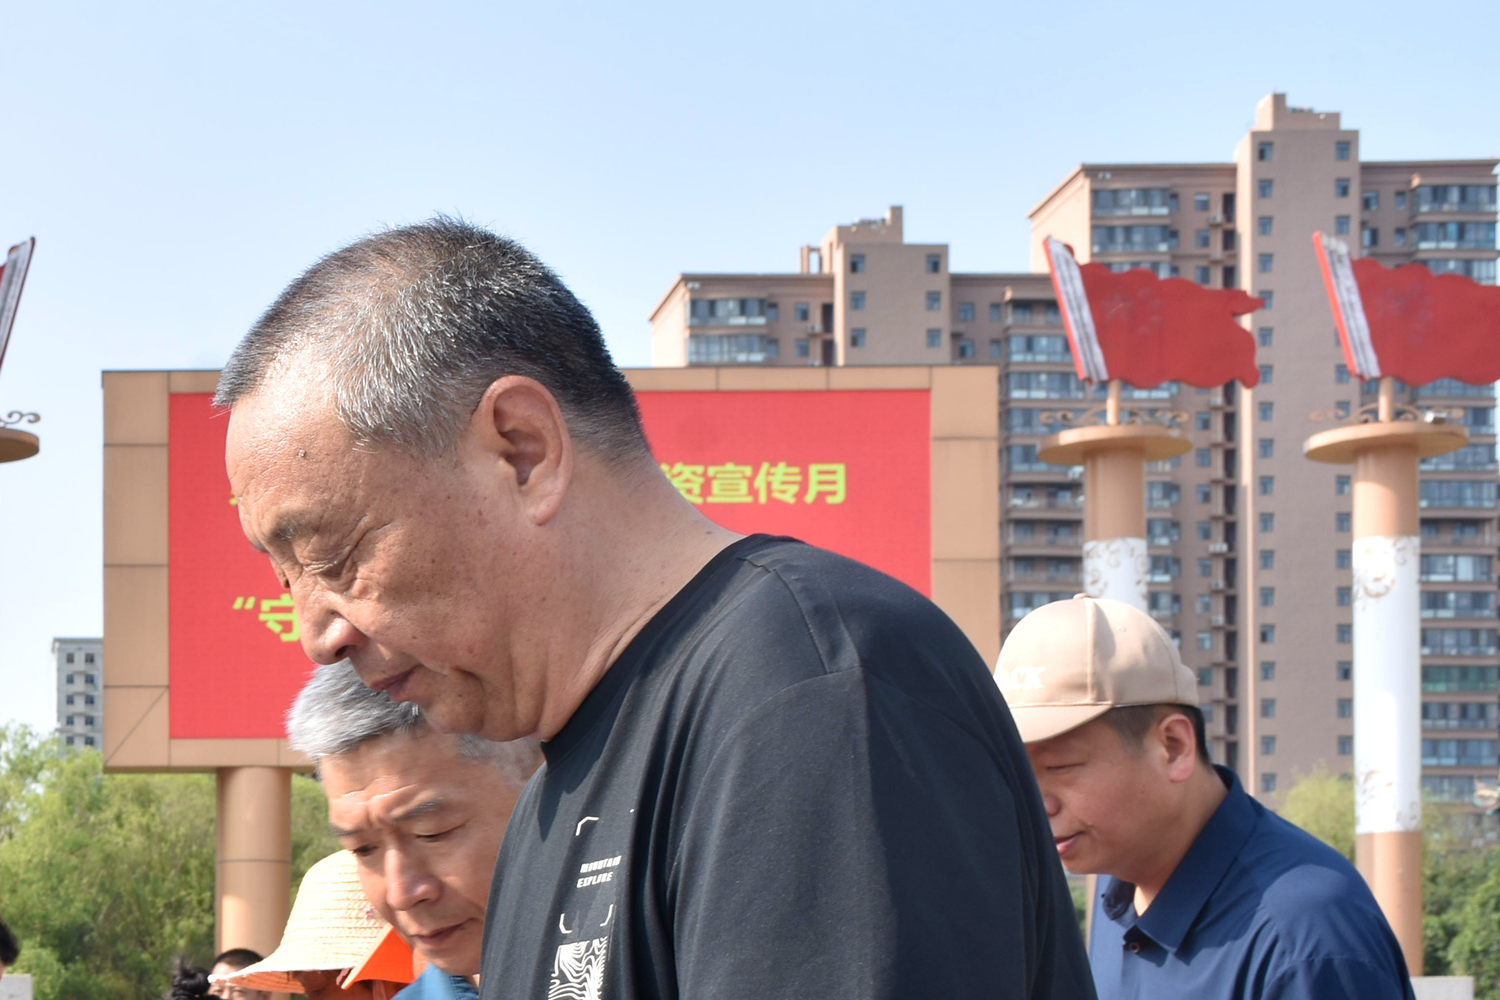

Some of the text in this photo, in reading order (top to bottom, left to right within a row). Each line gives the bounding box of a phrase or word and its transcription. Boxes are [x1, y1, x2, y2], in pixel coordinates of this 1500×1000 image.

[660, 461, 847, 504] 资宣传月
[580, 855, 622, 873] MOUNTAIN
[576, 871, 613, 888] EXPLORE
